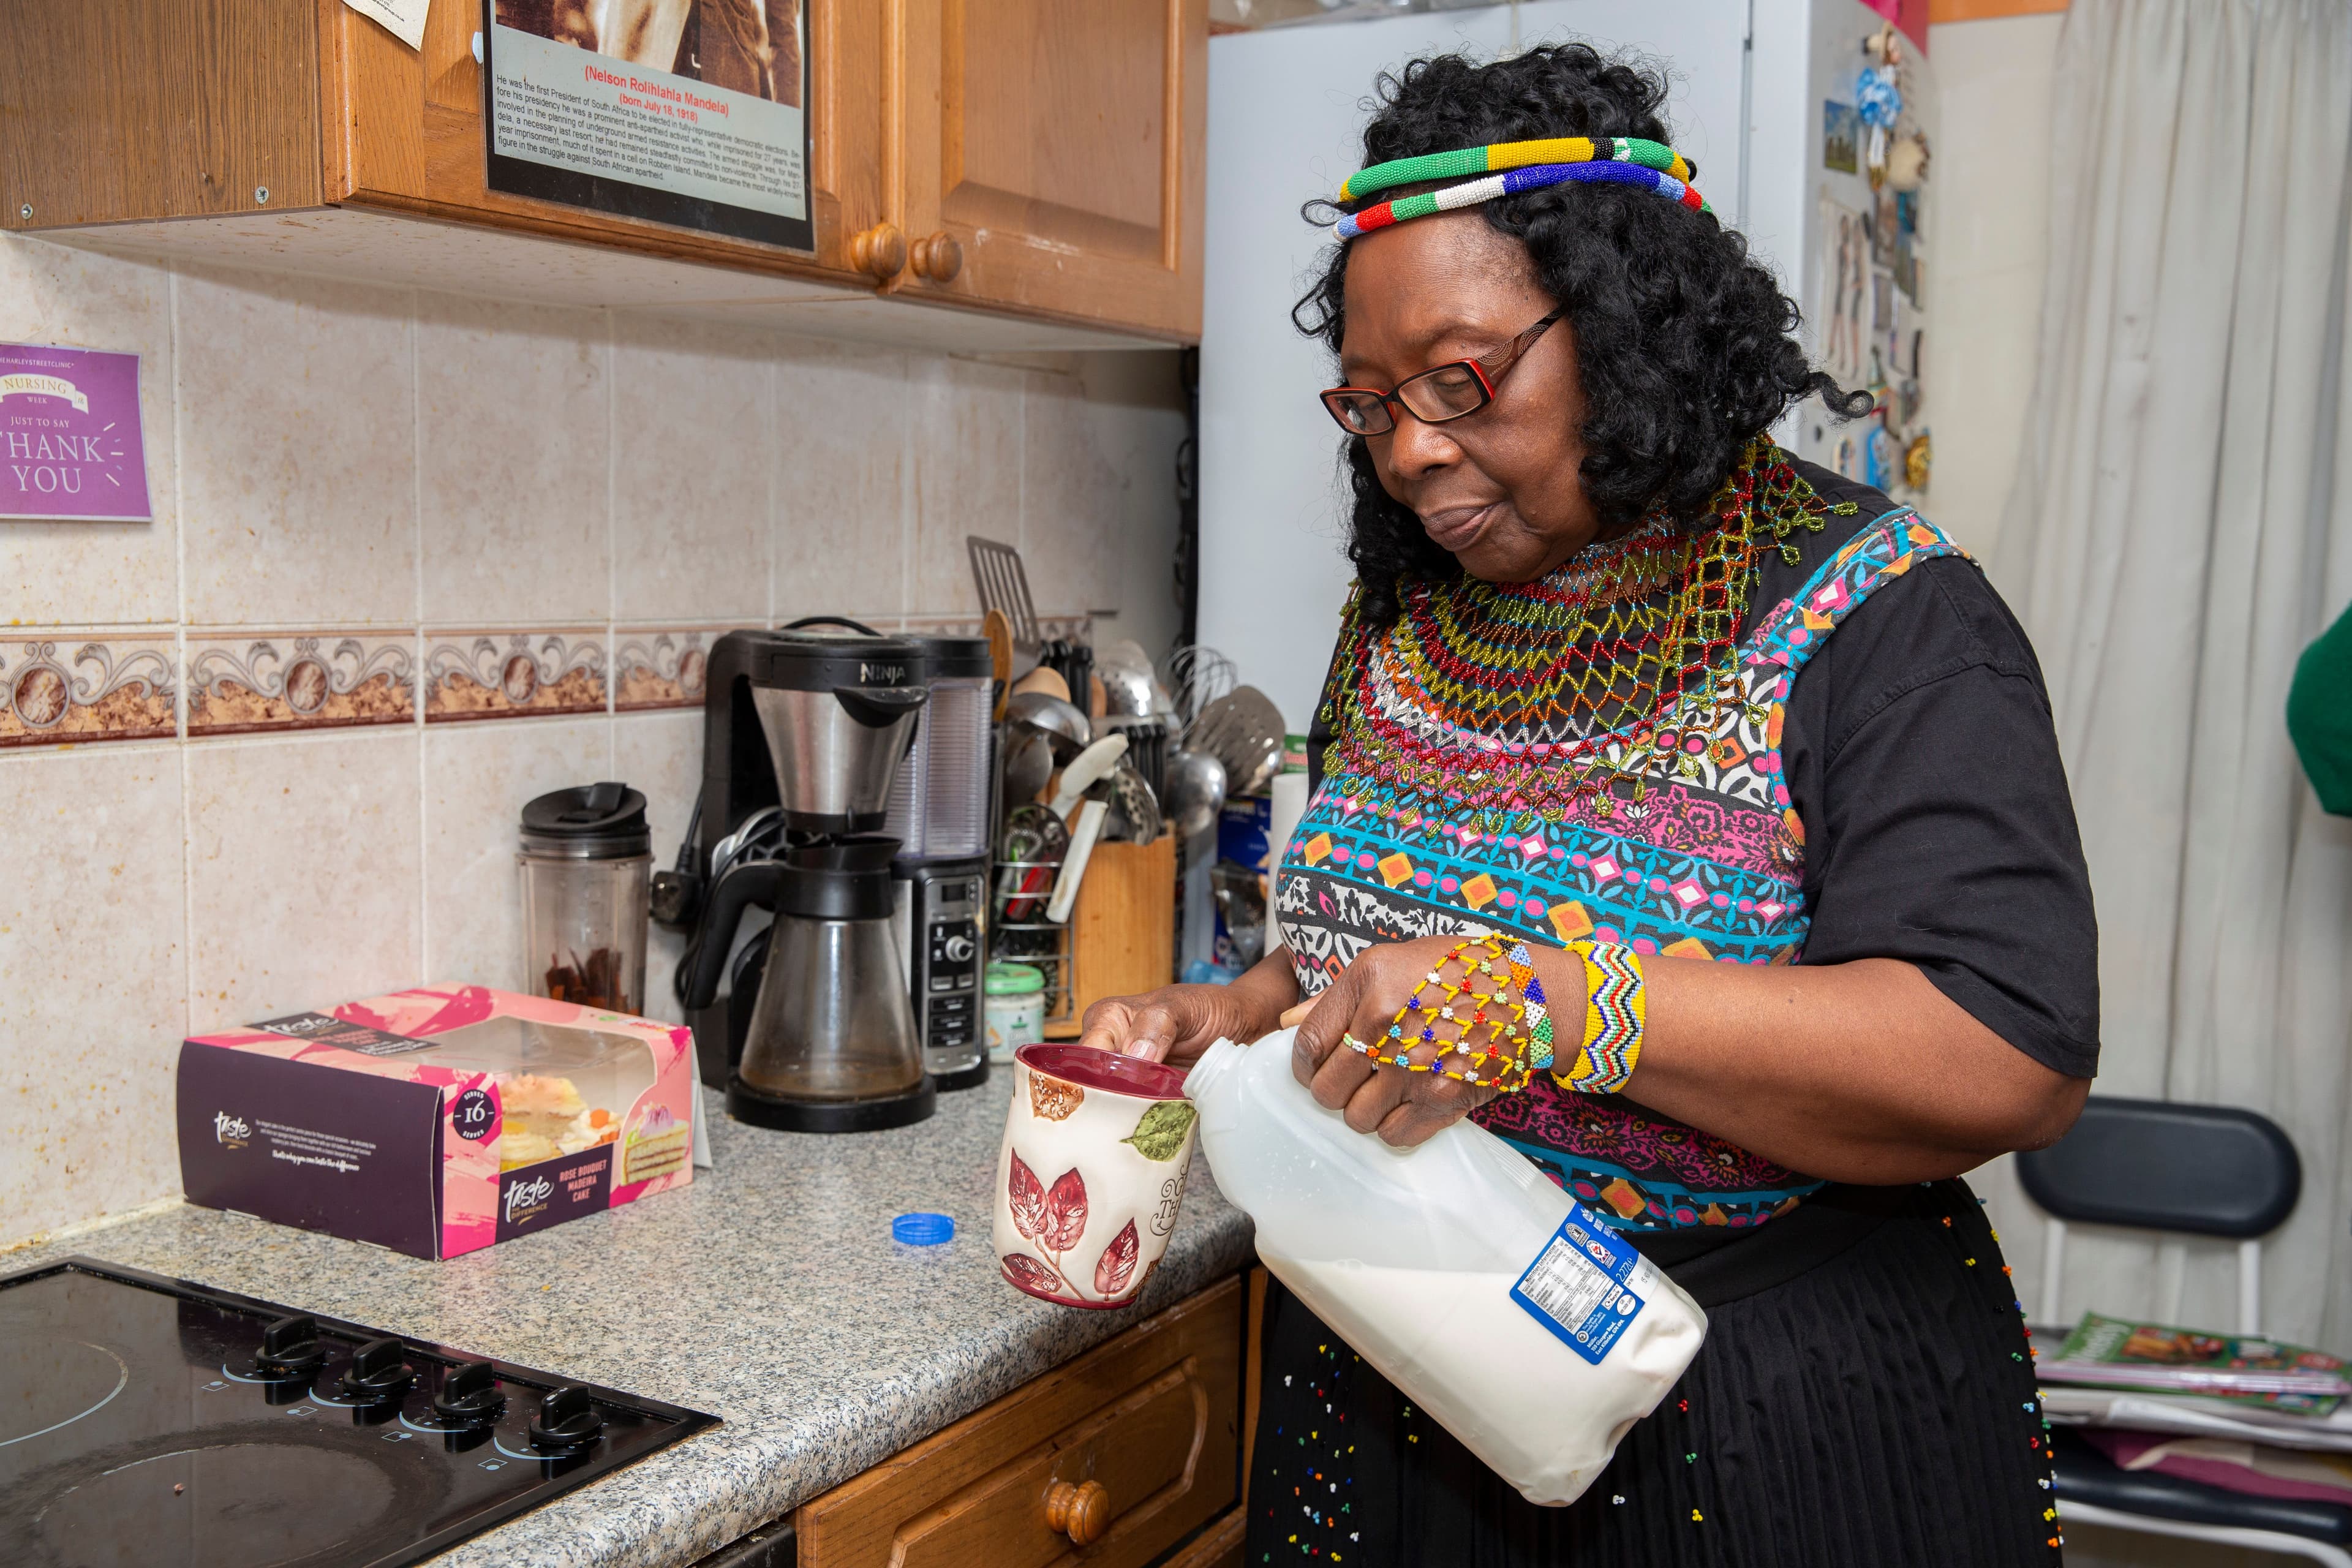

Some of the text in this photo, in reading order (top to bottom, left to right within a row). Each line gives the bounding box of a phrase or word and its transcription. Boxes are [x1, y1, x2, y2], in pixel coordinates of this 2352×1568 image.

[497, 74, 507, 85] He
[509, 79, 522, 89] was
[524, 81, 534, 91] the
[537, 84, 549, 95] first
[551, 88, 581, 104] President
[583, 97, 589, 105] of
[592, 99, 609, 111] South
[612, 104, 630, 116] Africa
[631, 109, 637, 118] to
[639, 111, 647, 121] be
[649, 114, 670, 126] elected
[672, 119, 677, 128] in
[585, 65, 728, 118] (Nelson Rolihlahla Mandela)
[497, 86, 510, 97] fore
[513, 91, 522, 100] his
[525, 95, 560, 111] presidency
[562, 103, 570, 112] he
[573, 107, 586, 116] was
[594, 112, 625, 126] prominent
[627, 121, 668, 137] anti-apartheid
[669, 131, 690, 142] activist
[619, 92, 698, 125] (born July 18, 1918)
[497, 99, 524, 113] involved
[527, 106, 533, 115] in
[535, 108, 546, 118] the
[548, 112, 576, 127] planning
[586, 123, 625, 138] underground
[628, 132, 647, 143] armed
[649, 138, 679, 151] resistance
[498, 126, 512, 134] year
[563, 140, 580, 149] much
[595, 148, 612, 157] spent
[614, 150, 619, 159] in
[627, 154, 637, 163] cell
[648, 158, 671, 171] Robben
[498, 135, 517, 148] figure
[519, 140, 525, 149] in
[527, 142, 537, 152] the
[539, 145, 565, 159] struggle
[567, 153, 590, 164] against
[592, 156, 609, 168] South
[612, 161, 633, 173] African
[523, 119, 557, 134] necessary
[559, 126, 570, 136] last
[595, 134, 603, 143] he
[605, 137, 617, 147] had
[619, 142, 647, 154] remained
[650, 148, 681, 164] steadfastly
[683, 157, 712, 169] committed
[4, 377, 66, 394] NURSING
[11, 417, 69, 428] JUST TO SAY
[0, 431, 105, 462] HANK
[10, 465, 81, 493] YOU
[860, 662, 906, 685] NINJA
[464, 1100, 486, 1123] 16
[214, 1110, 252, 1144] taste
[462, 1129, 484, 1139] SERVES
[559, 1159, 608, 1182] ROSE BOUQUET
[568, 1174, 597, 1191] MADEIRA
[503, 1175, 554, 1223] taste
[573, 1188, 591, 1202] CAKE
[1525, 1264, 1540, 1283] Nutrition
[1537, 1243, 1556, 1265] Information
[1610, 1289, 1620, 1302] Recycle
[1594, 1346, 1603, 1355] East
[1595, 1330, 1610, 1346] Glasgow
